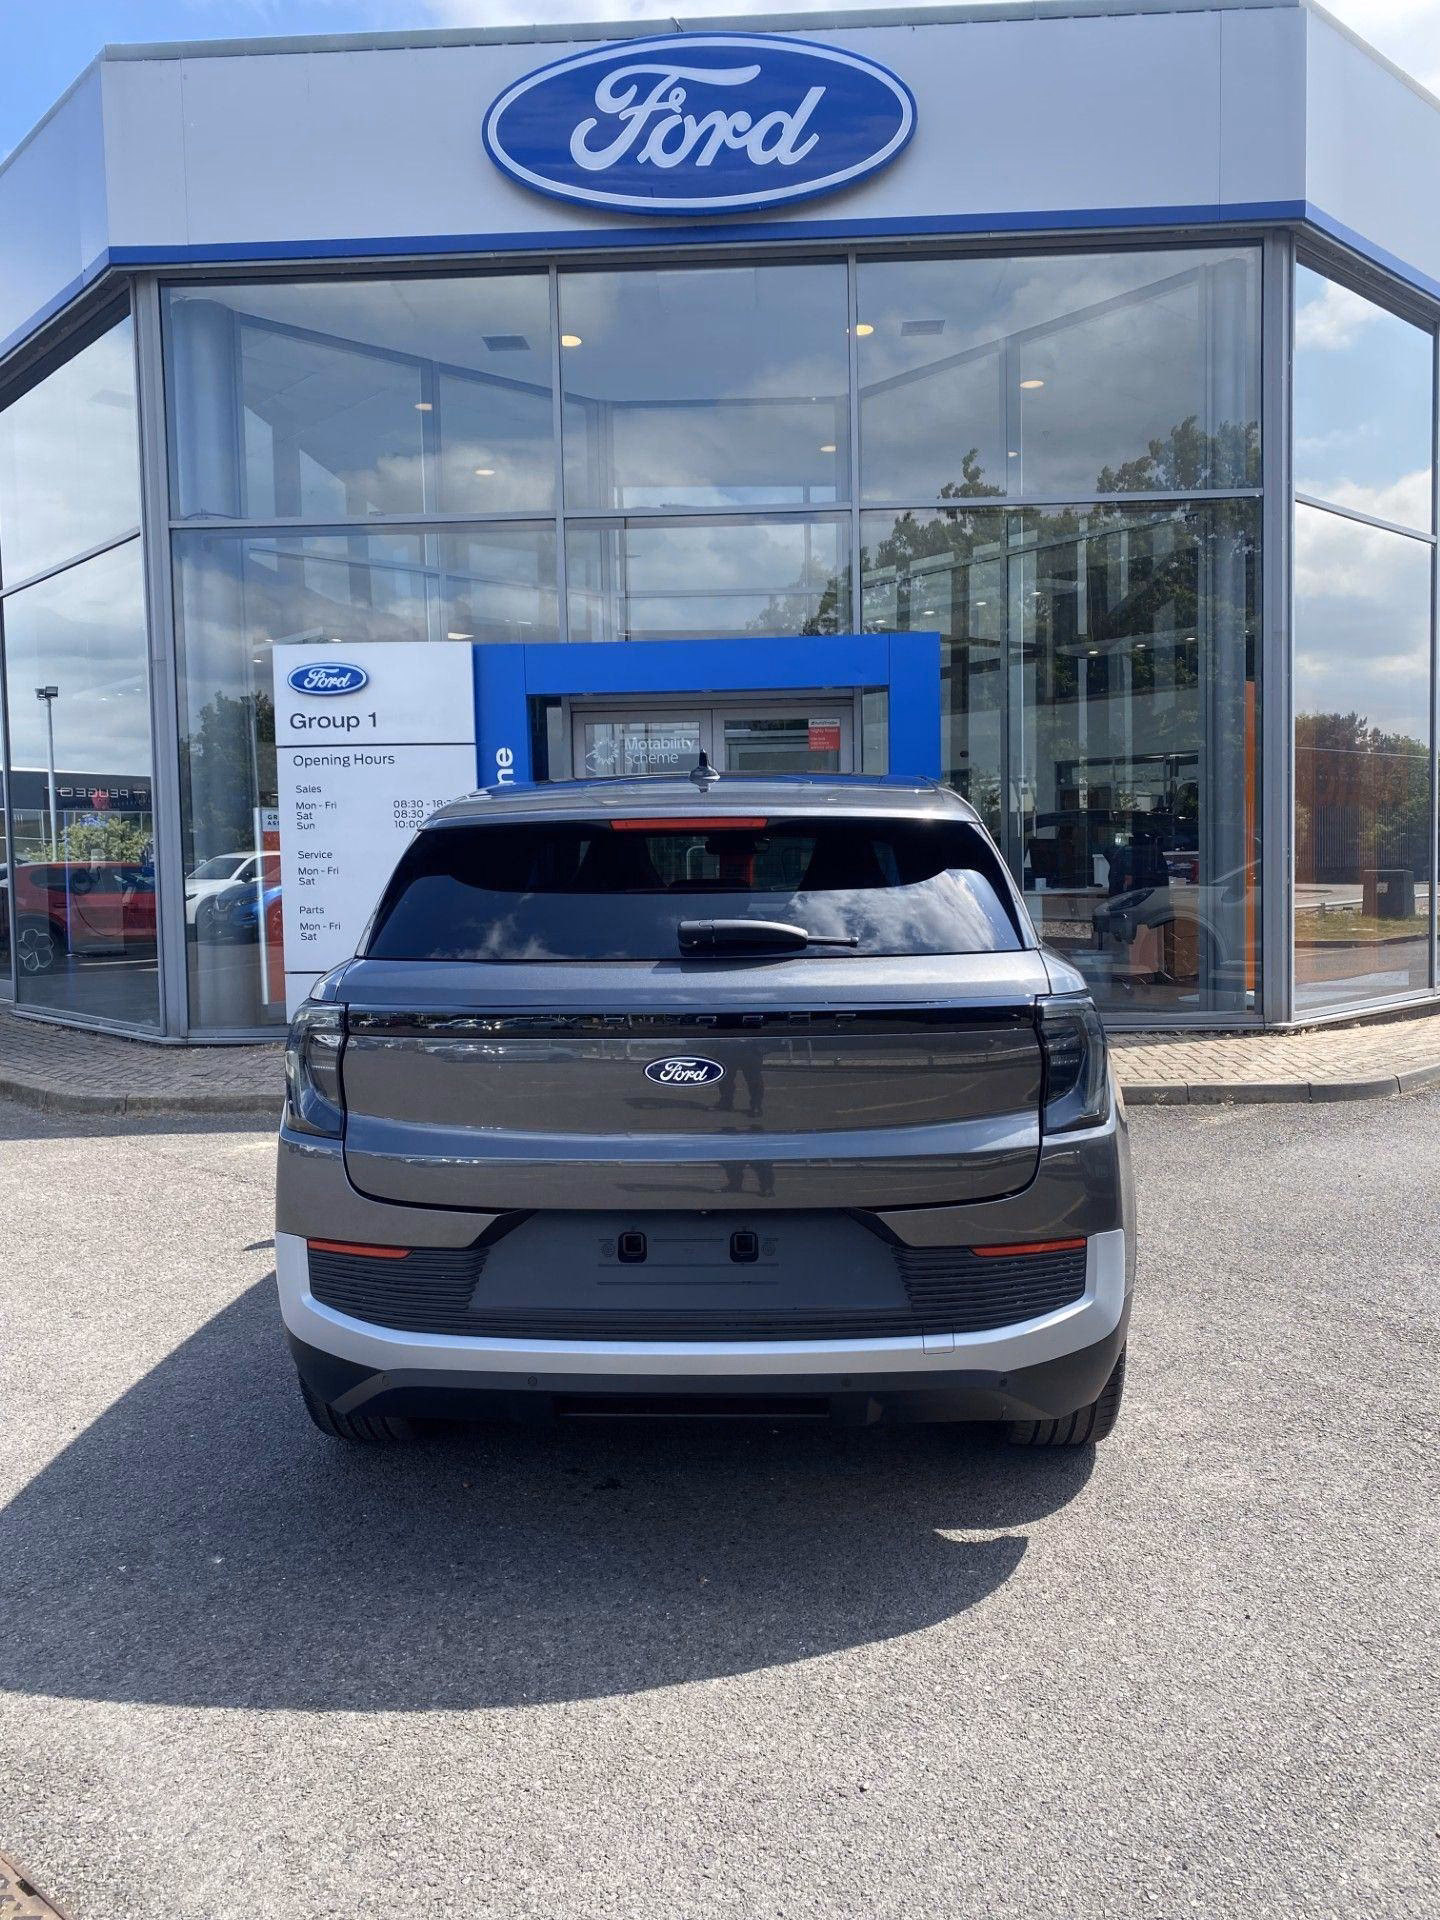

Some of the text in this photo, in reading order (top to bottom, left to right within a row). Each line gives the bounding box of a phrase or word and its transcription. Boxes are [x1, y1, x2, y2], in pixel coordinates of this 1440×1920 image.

[570, 64, 827, 171] Ford
[303, 667, 352, 689] Ford
[289, 711, 377, 733] Group 1
[624, 736, 696, 753] Motability
[292, 752, 396, 769] Opening Hours
[624, 751, 679, 765] Scheme
[295, 784, 322, 794] Sales
[295, 801, 317, 810] Mon
[324, 801, 338, 810] Fri
[393, 799, 424, 809] 08:30
[296, 811, 313, 821] Sat
[393, 809, 424, 819] 08:30
[296, 820, 423, 831] Sun 10:00
[297, 850, 333, 860] Service
[297, 866, 319, 876] Mon
[327, 866, 339, 875] Fri
[298, 877, 315, 886] Sat
[299, 905, 325, 915] Parts
[299, 922, 321, 931] Mon
[328, 921, 341, 931] Fri
[300, 932, 317, 941] Sat
[659, 1061, 709, 1081] Ford
